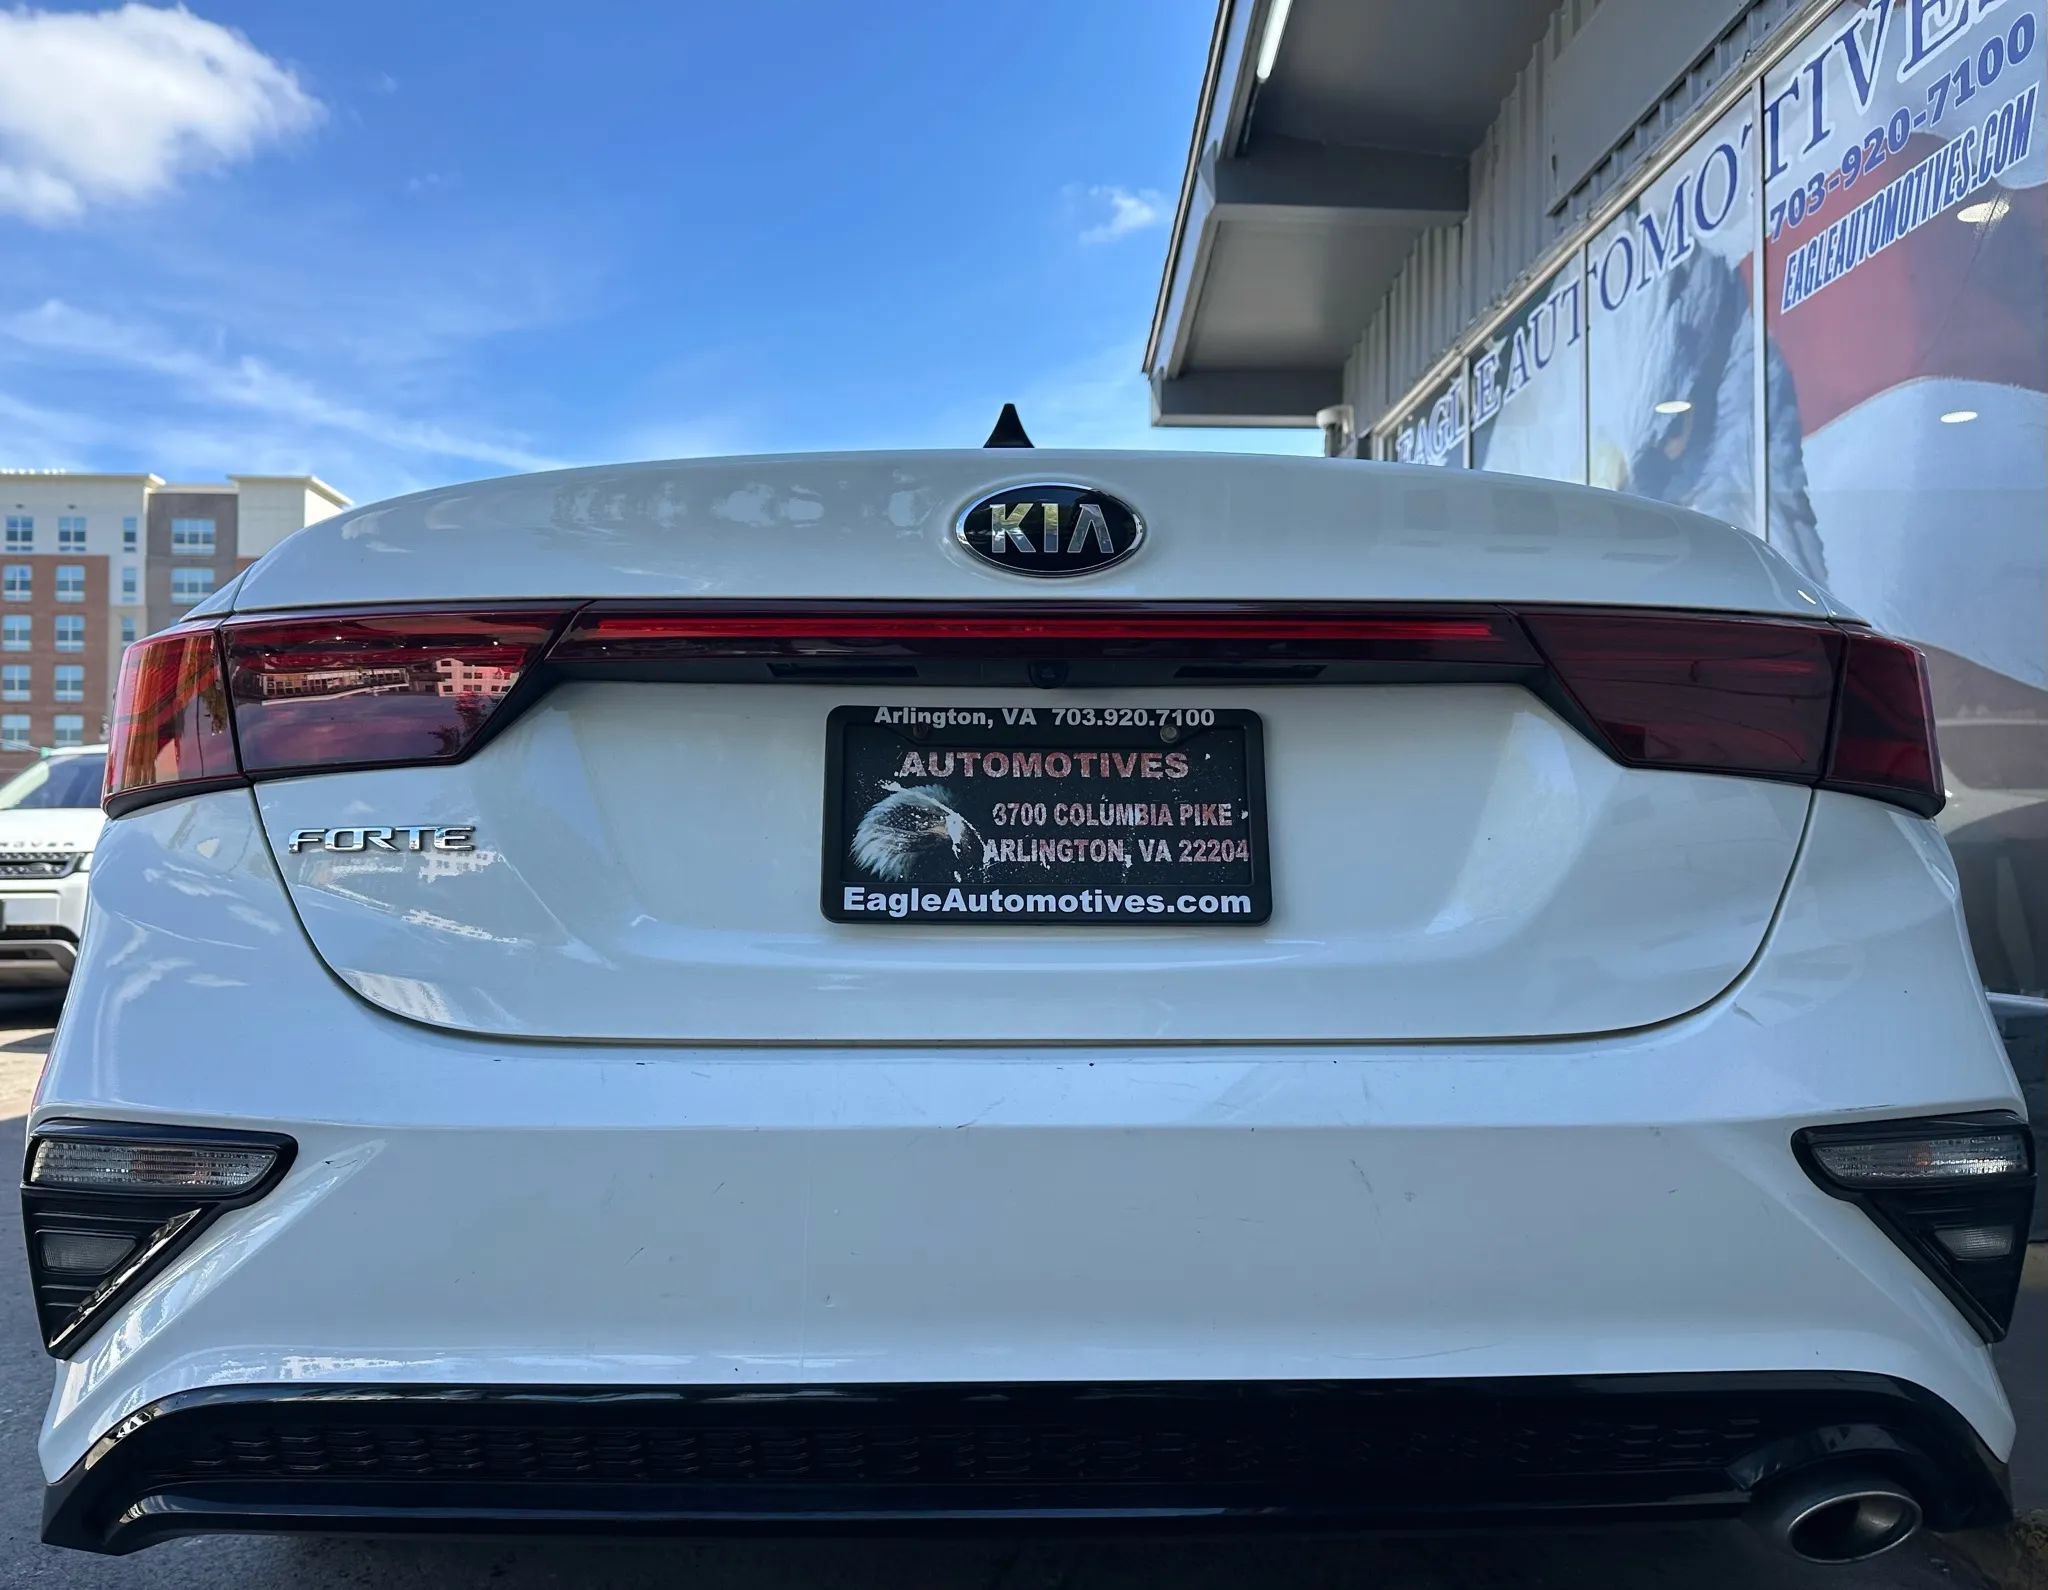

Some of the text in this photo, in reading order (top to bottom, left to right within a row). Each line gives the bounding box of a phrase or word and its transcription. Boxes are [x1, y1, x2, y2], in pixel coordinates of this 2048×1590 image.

[1770, 12, 2036, 243] 703-920-7100
[1781, 81, 2040, 313] EAGLEAUTOMOTIVES.COM
[989, 503, 1115, 553] KIA
[874, 706, 1216, 729] Arlington, VA 703.920.7100
[899, 751, 1190, 778] AUTOMOTIVES
[992, 803, 1232, 826] 3700 COLUMBIA PIKE
[288, 825, 474, 853] FORTE
[982, 839, 1250, 867] ARLINGTON, VA 22204
[843, 886, 1252, 917] EagleAutomotives.com
